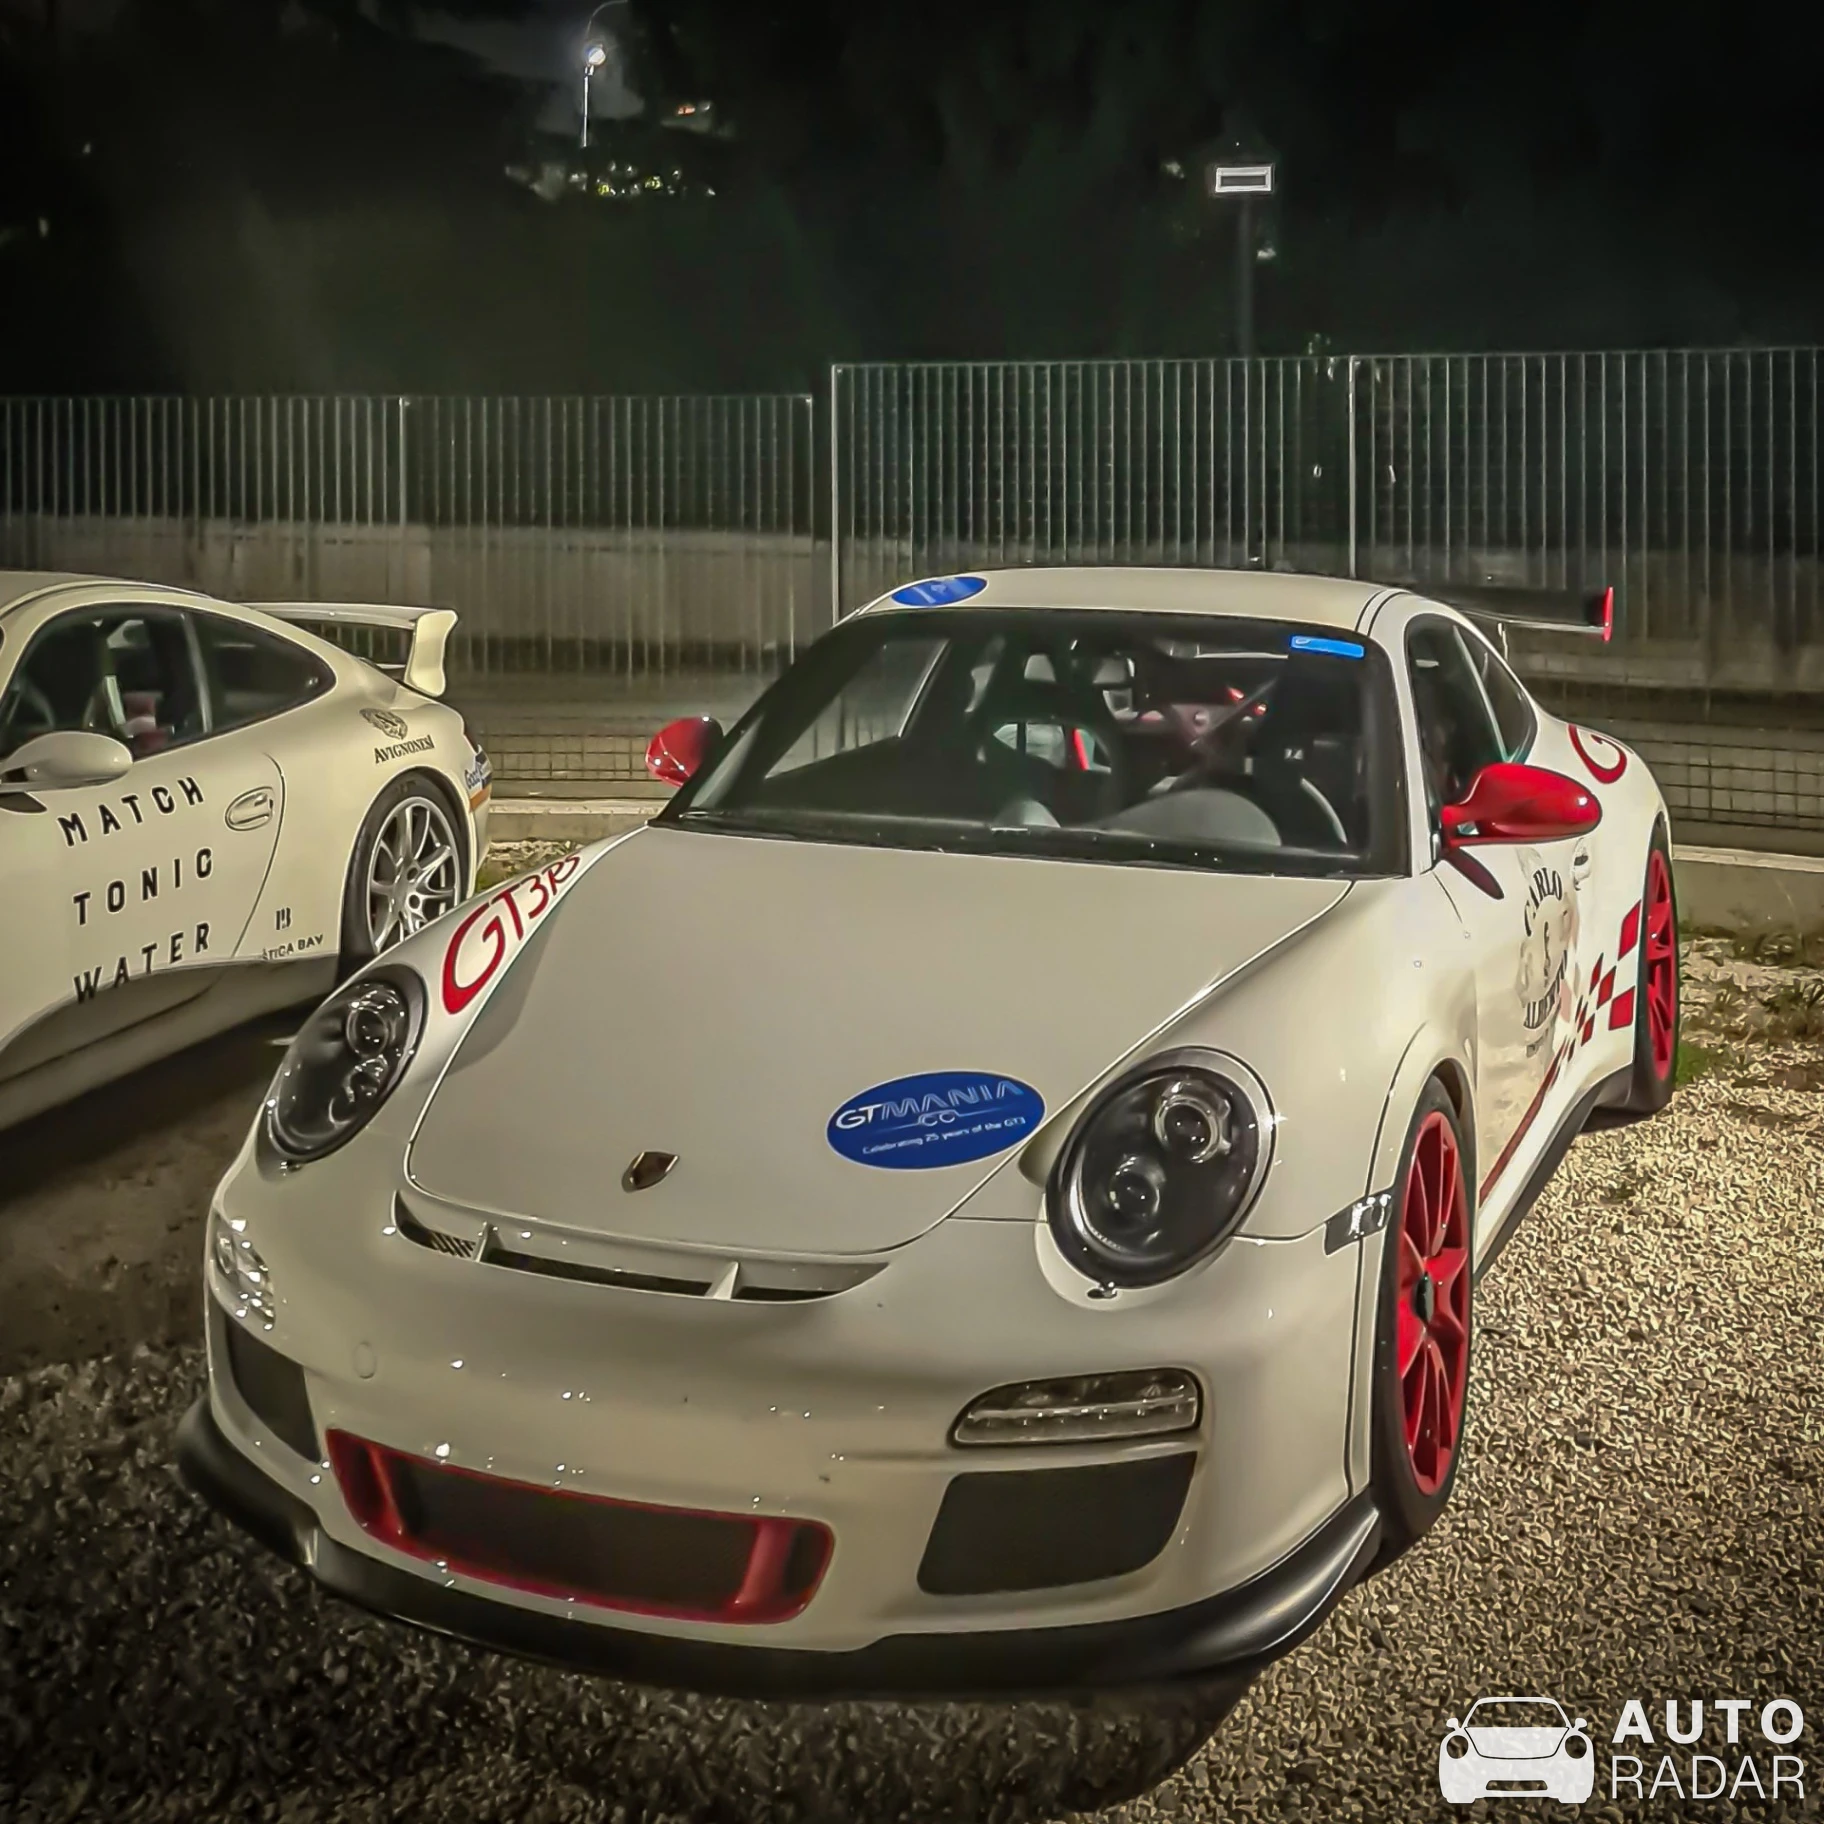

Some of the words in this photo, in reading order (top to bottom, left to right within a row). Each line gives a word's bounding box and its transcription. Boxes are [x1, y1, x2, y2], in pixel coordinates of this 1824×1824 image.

[57, 776, 205, 847] MATCH
[72, 847, 214, 926] TONIC
[73, 922, 212, 1004] WATER
